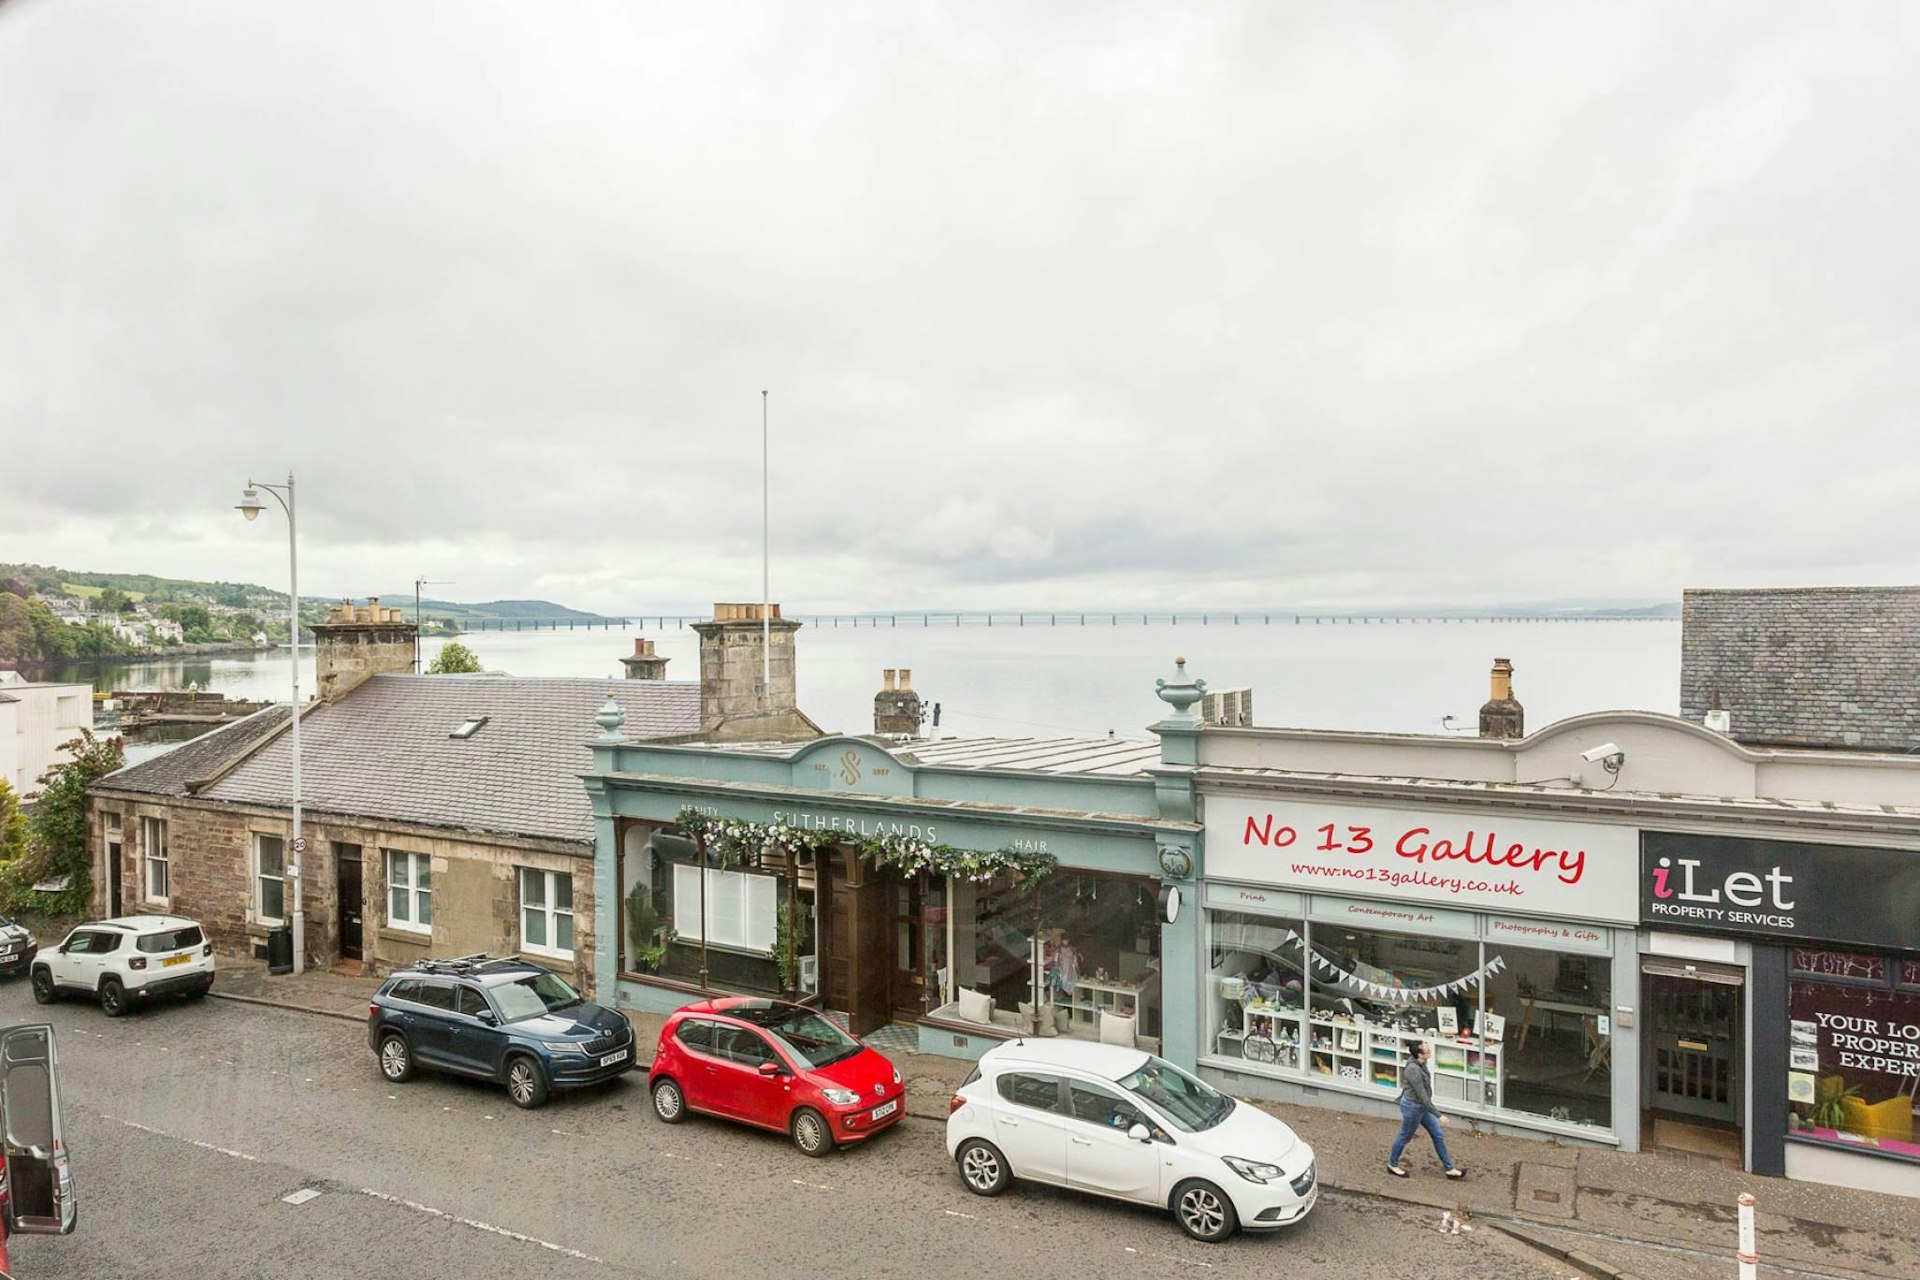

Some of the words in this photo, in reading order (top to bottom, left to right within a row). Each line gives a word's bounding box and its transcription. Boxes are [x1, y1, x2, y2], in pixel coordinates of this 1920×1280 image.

[773, 811, 937, 843] SUTHERLANDS
[1014, 838, 1048, 852] HAIR
[1243, 814, 1297, 847] No
[1316, 823, 1374, 854] 13
[1394, 827, 1585, 884] Gallery
[1291, 863, 1524, 896] www.no13gallery.co.uk
[1652, 857, 1795, 910] iLet
[1240, 891, 1267, 903] Prints
[1348, 904, 1414, 922] Contemporary
[1417, 912, 1434, 923] Art
[1651, 902, 1725, 921] PROPERTY
[1728, 910, 1795, 929] SERVICES
[1494, 920, 1558, 938] Photography
[1561, 928, 1570, 938] &
[1574, 930, 1600, 942] Gifts
[1815, 1012, 1879, 1035] YOUR
[1839, 1051, 1920, 1077] EXPER
